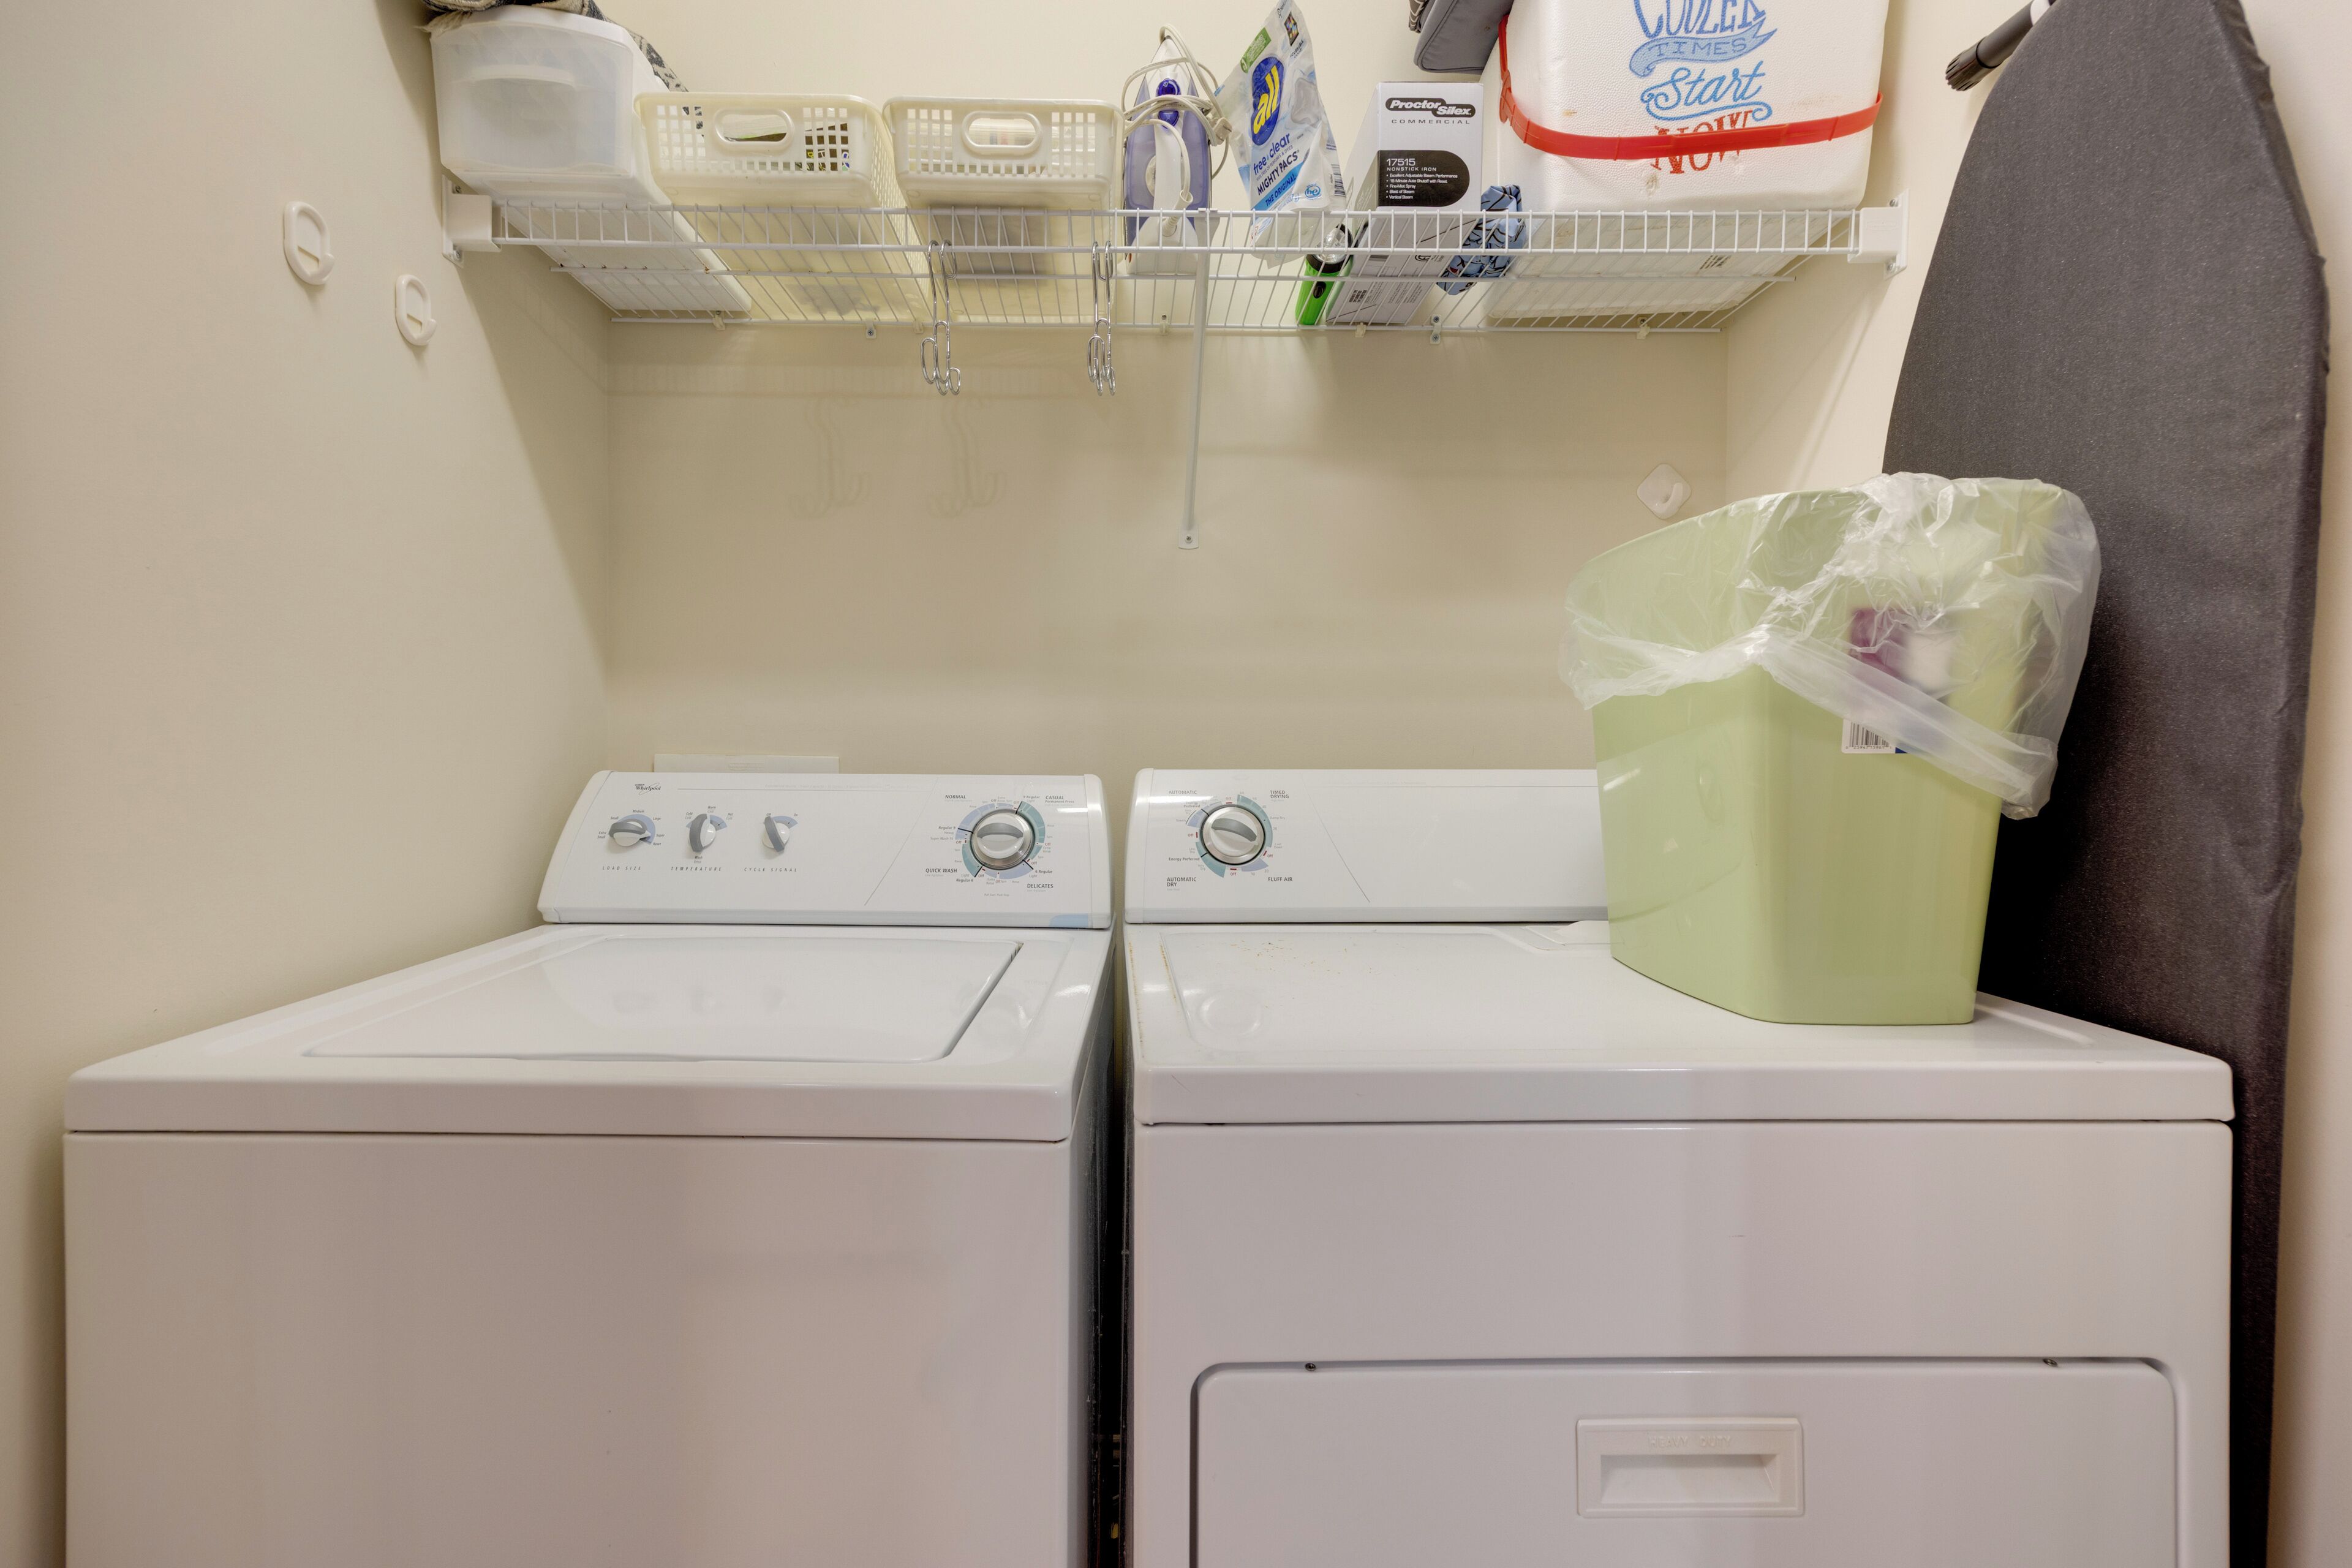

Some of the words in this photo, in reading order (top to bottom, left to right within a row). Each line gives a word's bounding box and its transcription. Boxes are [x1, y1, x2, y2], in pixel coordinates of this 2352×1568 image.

[1646, 37, 1747, 56] TIMES
[1253, 64, 1280, 135] all
[1641, 61, 1766, 111] Start
[1390, 100, 1442, 109] Proctor
[1436, 105, 1472, 116] Silex
[1254, 156, 1267, 175] free
[1269, 133, 1290, 158] clear
[1257, 166, 1280, 196] MIGHTY
[1279, 151, 1298, 173] PACS
[1265, 193, 1275, 206] THE
[1275, 173, 1296, 198] ORIGINAL
[1649, 1435, 1688, 1447] HEAVY
[1699, 1435, 1732, 1447] DUTY
